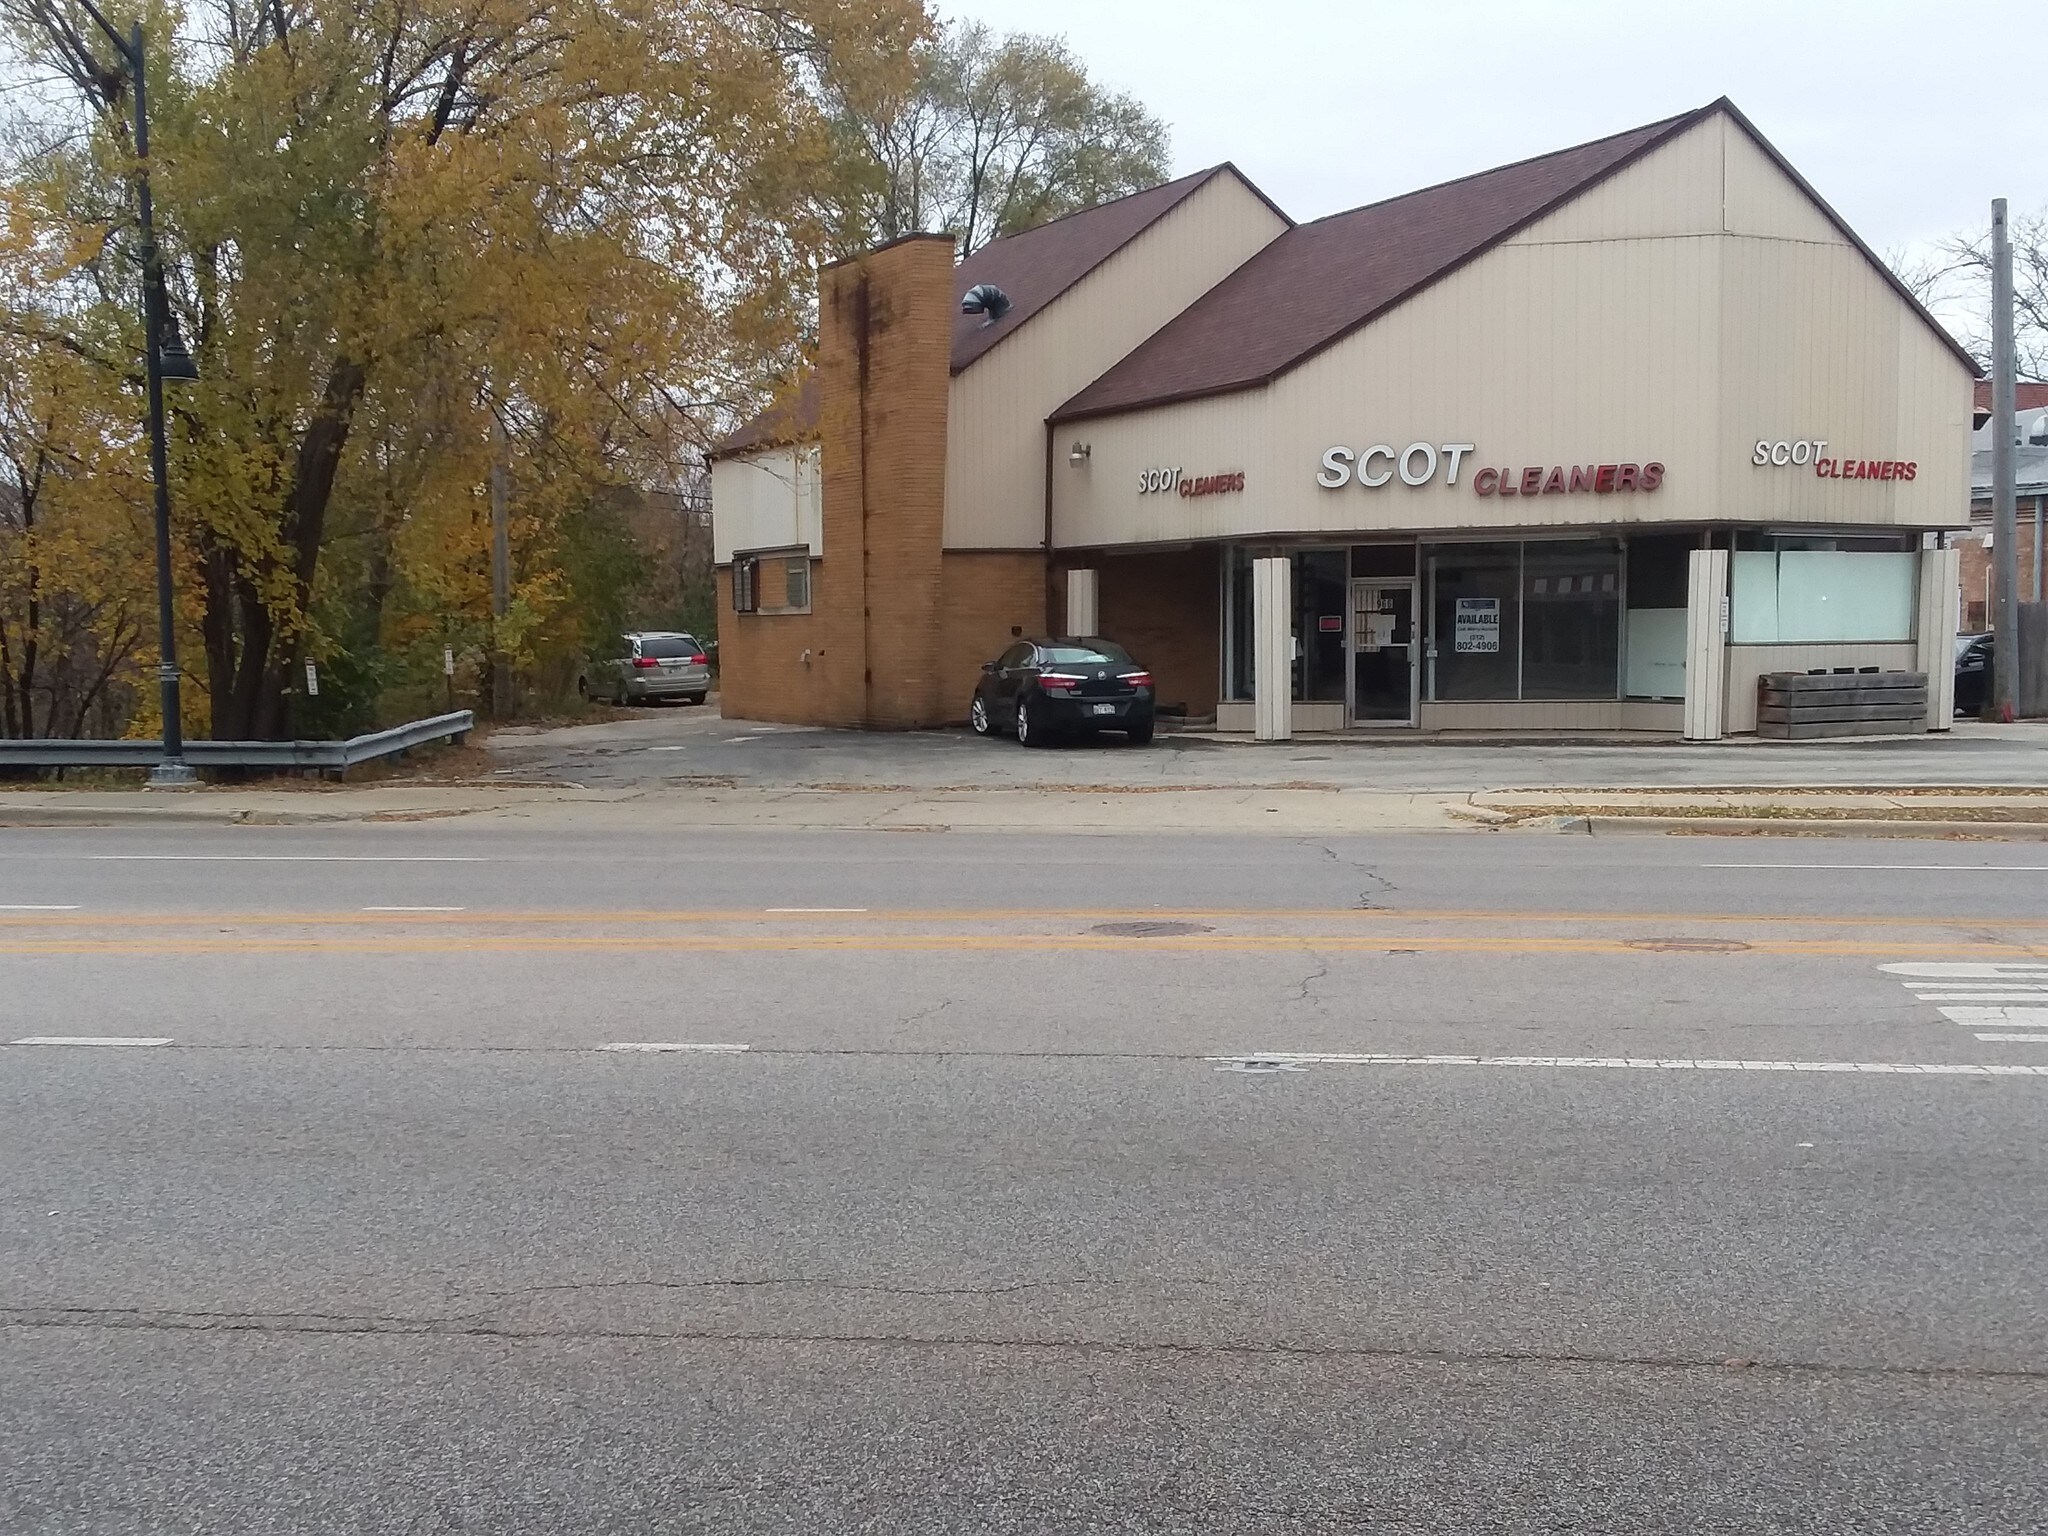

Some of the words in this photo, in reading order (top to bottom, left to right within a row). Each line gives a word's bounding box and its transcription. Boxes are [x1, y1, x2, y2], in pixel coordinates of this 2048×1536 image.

[1316, 441, 1476, 489] SCOT
[1473, 461, 1666, 497] CLEANERS
[1752, 440, 1828, 466] SCOT
[1816, 458, 1918, 481] CLEANERS
[1138, 467, 1182, 494] SCOT
[1179, 471, 1245, 498] CLEANERS
[1457, 614, 1499, 625] AVAILABLE
